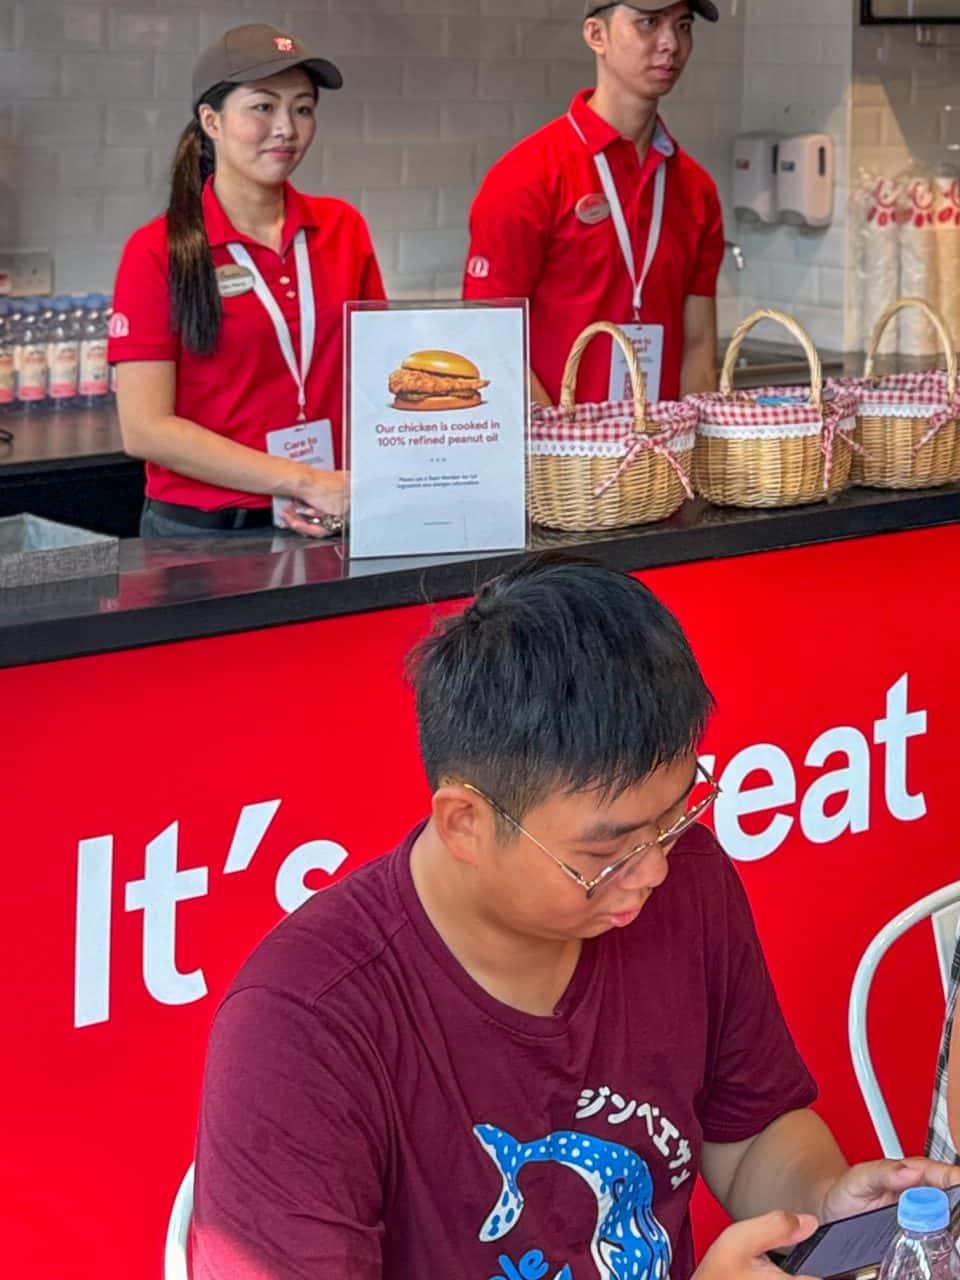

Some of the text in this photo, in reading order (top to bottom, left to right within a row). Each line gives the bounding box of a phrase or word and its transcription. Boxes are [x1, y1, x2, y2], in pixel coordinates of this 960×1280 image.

[375, 419, 501, 434] Our chicken is cooked in
[378, 432, 499, 447] 100% refined peanut oil
